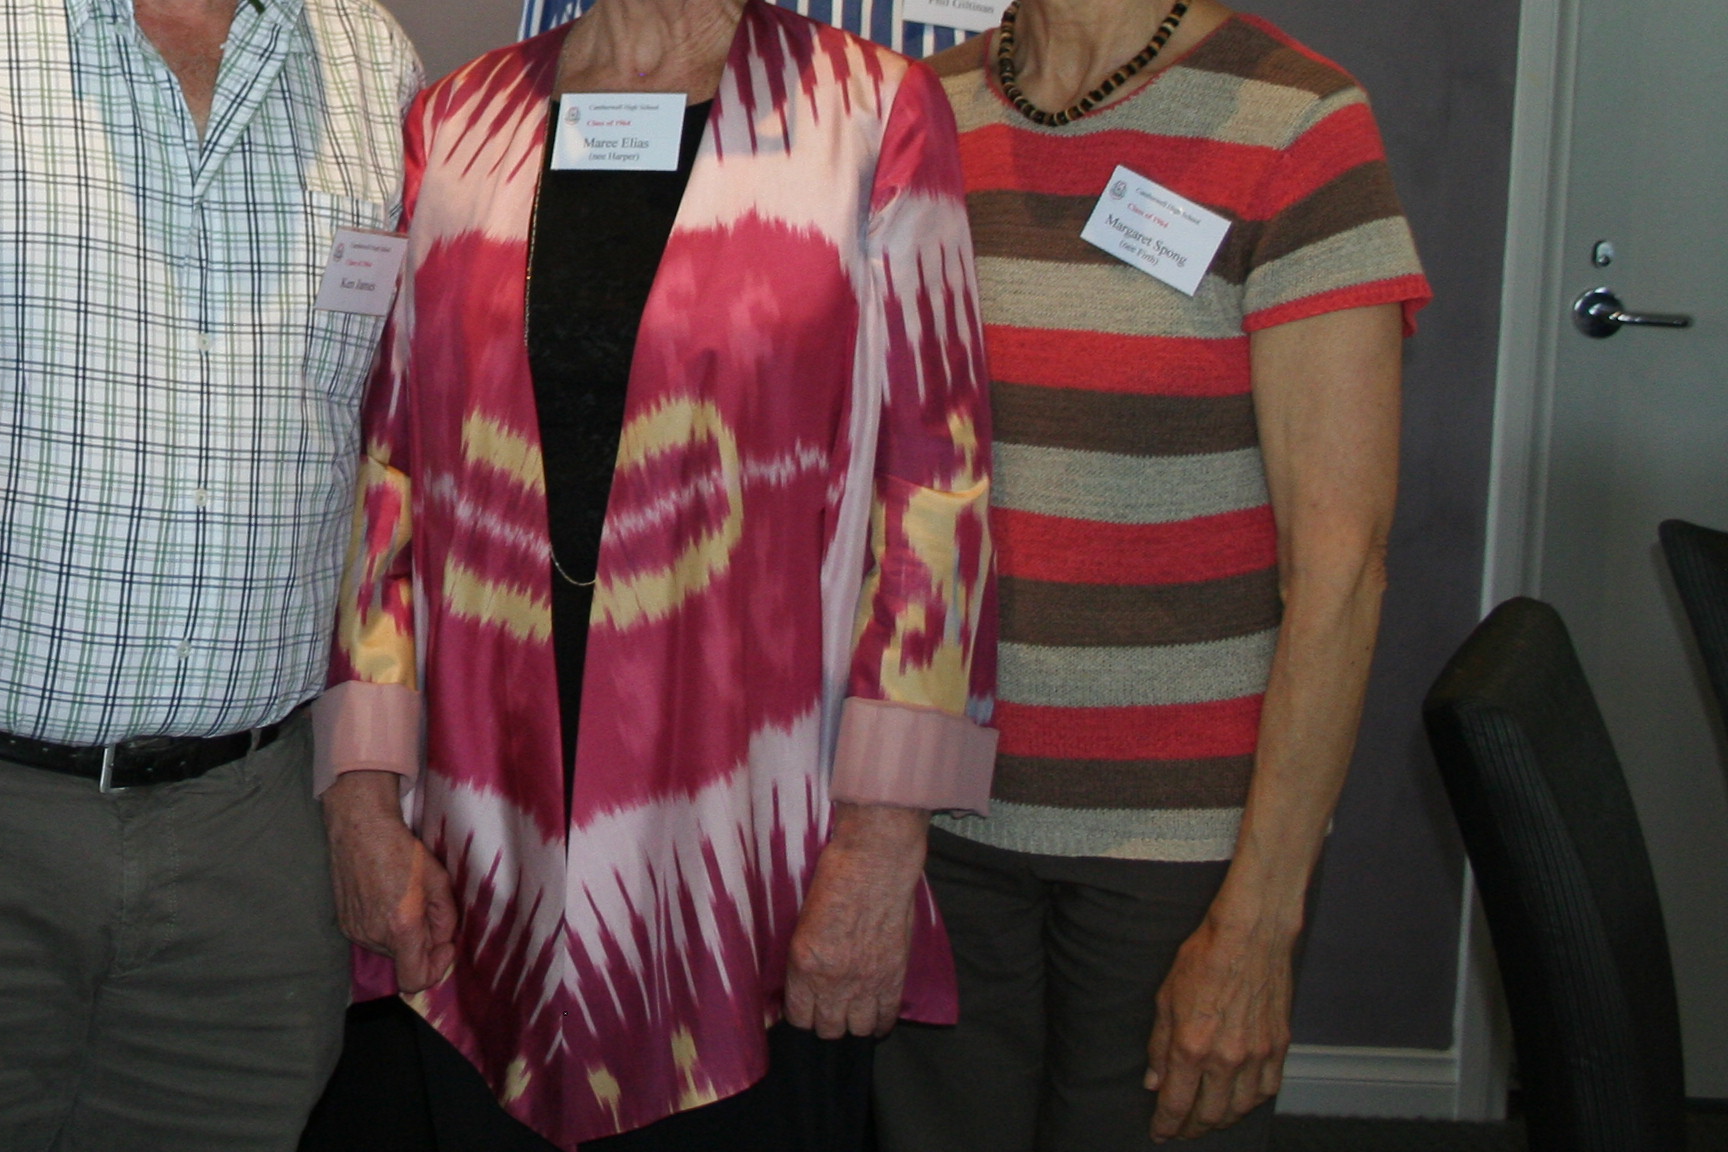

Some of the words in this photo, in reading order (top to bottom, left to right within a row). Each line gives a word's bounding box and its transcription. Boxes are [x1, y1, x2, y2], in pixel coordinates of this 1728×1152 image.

[584, 137, 617, 148] Maree
[621, 137, 649, 148] Elias
[1104, 214, 1152, 248] Margaret
[1153, 240, 1189, 268] Spong
